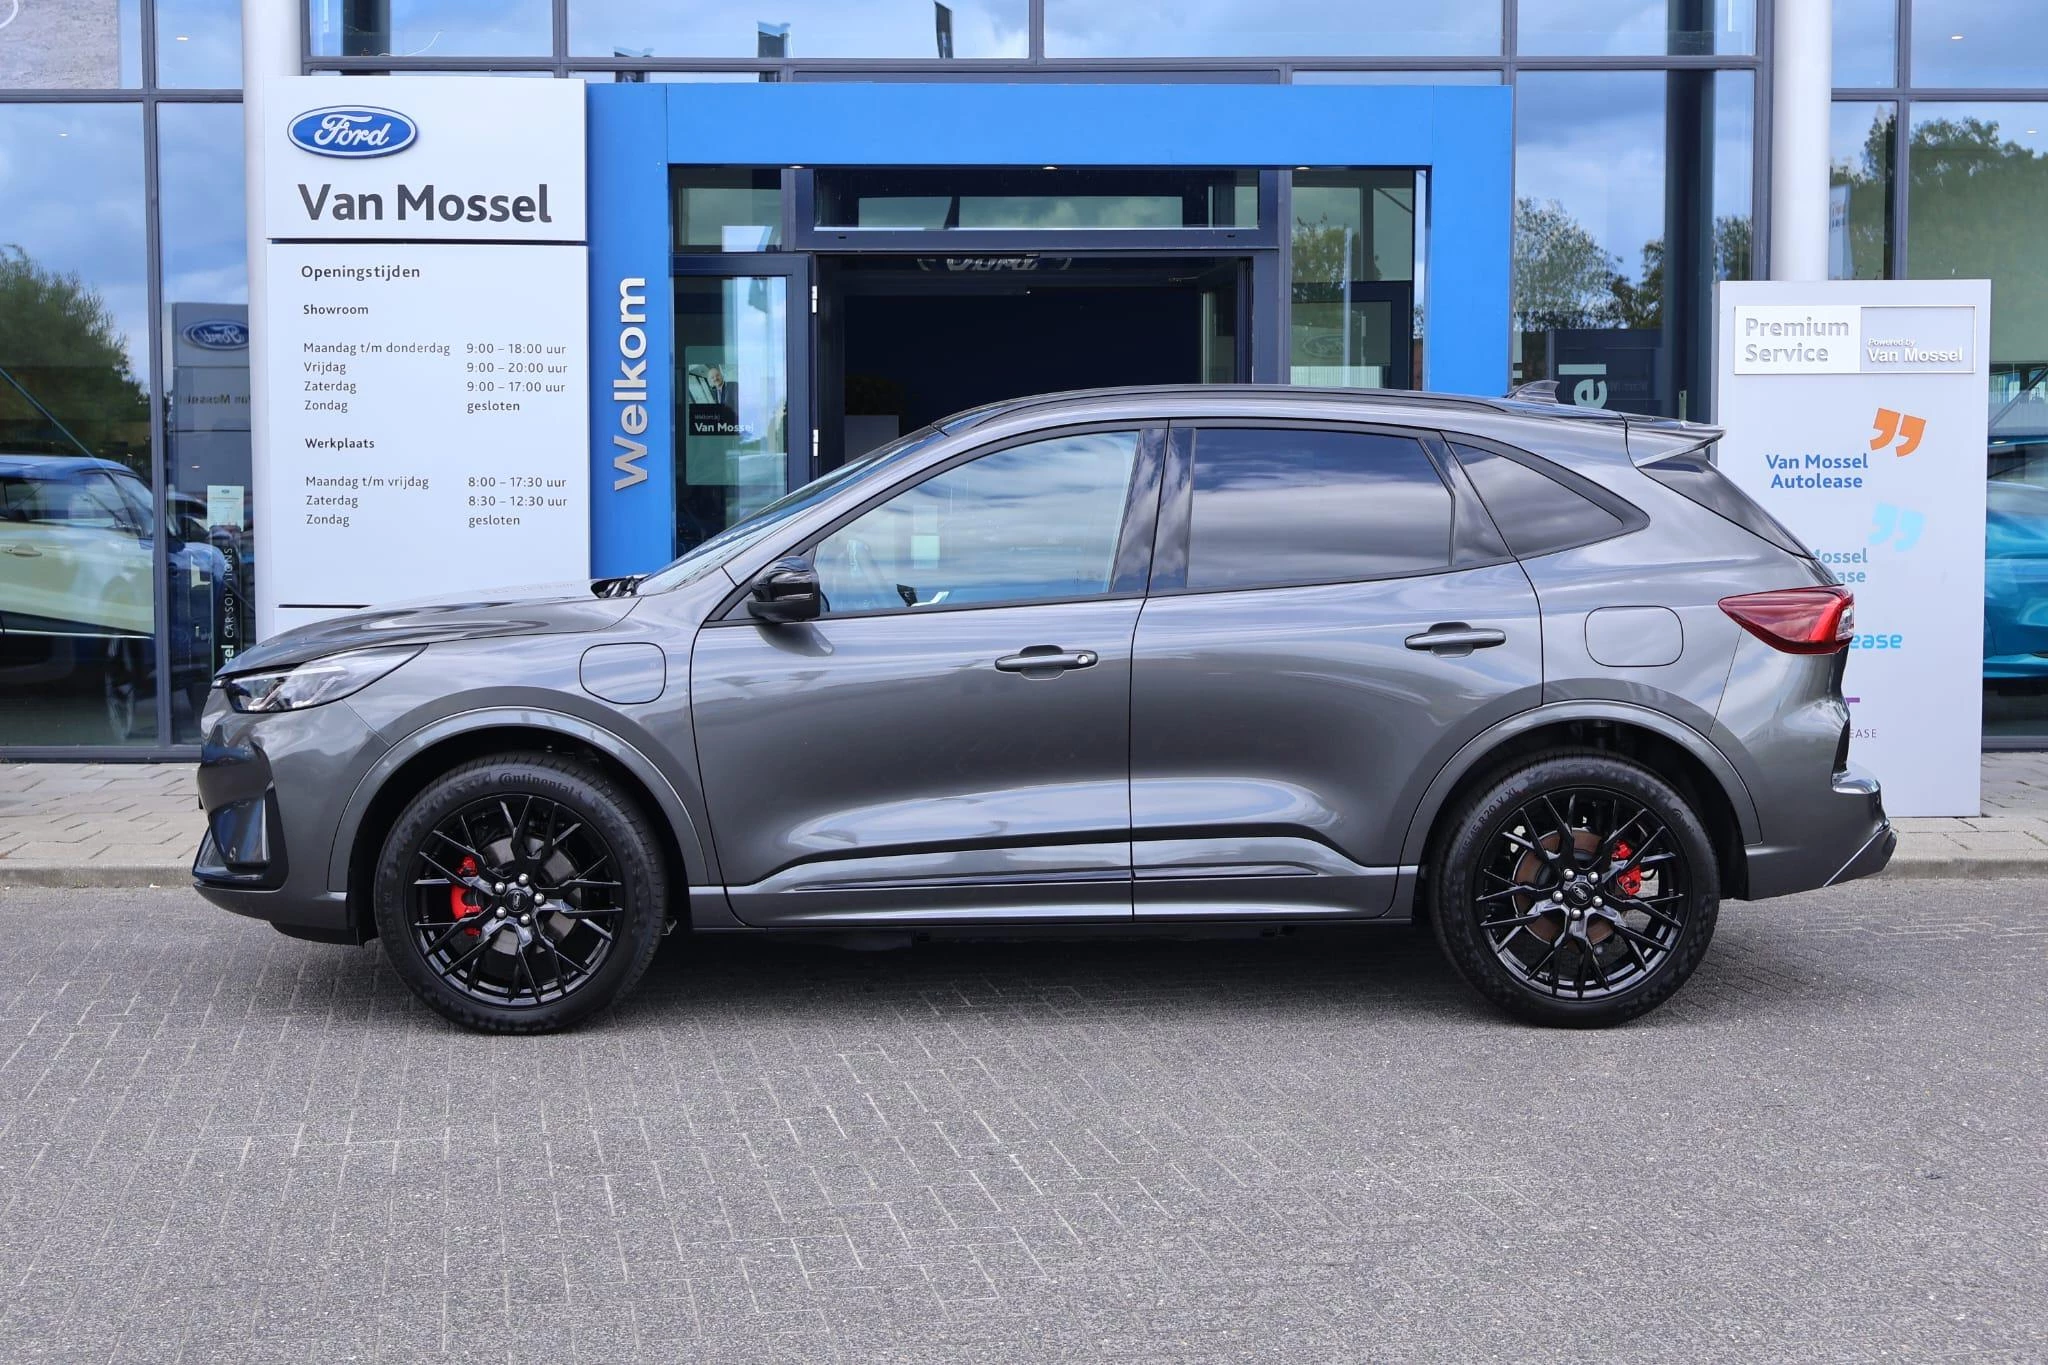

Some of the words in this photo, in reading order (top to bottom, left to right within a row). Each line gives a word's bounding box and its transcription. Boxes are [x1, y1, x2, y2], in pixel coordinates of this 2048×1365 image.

[314, 114, 391, 146] Ford
[298, 184, 383, 220] Van
[397, 184, 552, 222] Mossel
[301, 265, 420, 281] Openingstijden
[303, 304, 369, 315] Showroom
[1745, 317, 1849, 336] Premium
[303, 342, 356, 356] Maandag
[360, 342, 382, 353] t/m
[386, 343, 450, 356] donderdag
[466, 343, 494, 354] 9:00
[508, 343, 542, 354] 18:00
[546, 345, 566, 354] uur
[1867, 338, 1904, 347] Powered
[1905, 338, 1916, 348] by
[1745, 343, 1828, 362] Service
[1867, 348, 1899, 363] Van
[1904, 347, 1963, 363] Mossel
[303, 362, 346, 375] Vrijdag
[466, 362, 494, 373] 9:00
[508, 363, 544, 373] 20:00
[547, 364, 568, 373] uur
[304, 381, 357, 394] Zaterdag
[467, 381, 495, 392] 9:00
[509, 381, 541, 392] 17:00
[545, 383, 565, 392] uur
[613, 277, 648, 491] Welkom
[304, 400, 348, 413] Zondag
[467, 401, 520, 413] gesloten
[695, 423, 714, 432] Van
[718, 423, 753, 432] Mossel
[305, 438, 375, 451] Werkplaats
[1765, 455, 1799, 469] Van
[1805, 453, 1868, 469] Mossel
[306, 476, 359, 489] Maandag
[362, 476, 384, 487] t/m
[388, 476, 429, 490] vrijdag
[468, 477, 496, 487] 8:00
[510, 477, 543, 487] 17:30
[546, 479, 566, 487] uur
[1770, 473, 1863, 488] Autolease
[306, 495, 359, 508] Zaterdag
[468, 496, 496, 507] 8:30
[510, 496, 544, 507] 12:30
[547, 498, 567, 507] uur
[306, 514, 350, 527] Zondag
[468, 515, 520, 528] gesloten
[223, 547, 234, 613] SOLTIONS
[224, 616, 234, 638] CAR
[498, 772, 574, 795] Continental
[1479, 805, 1496, 824] R20
